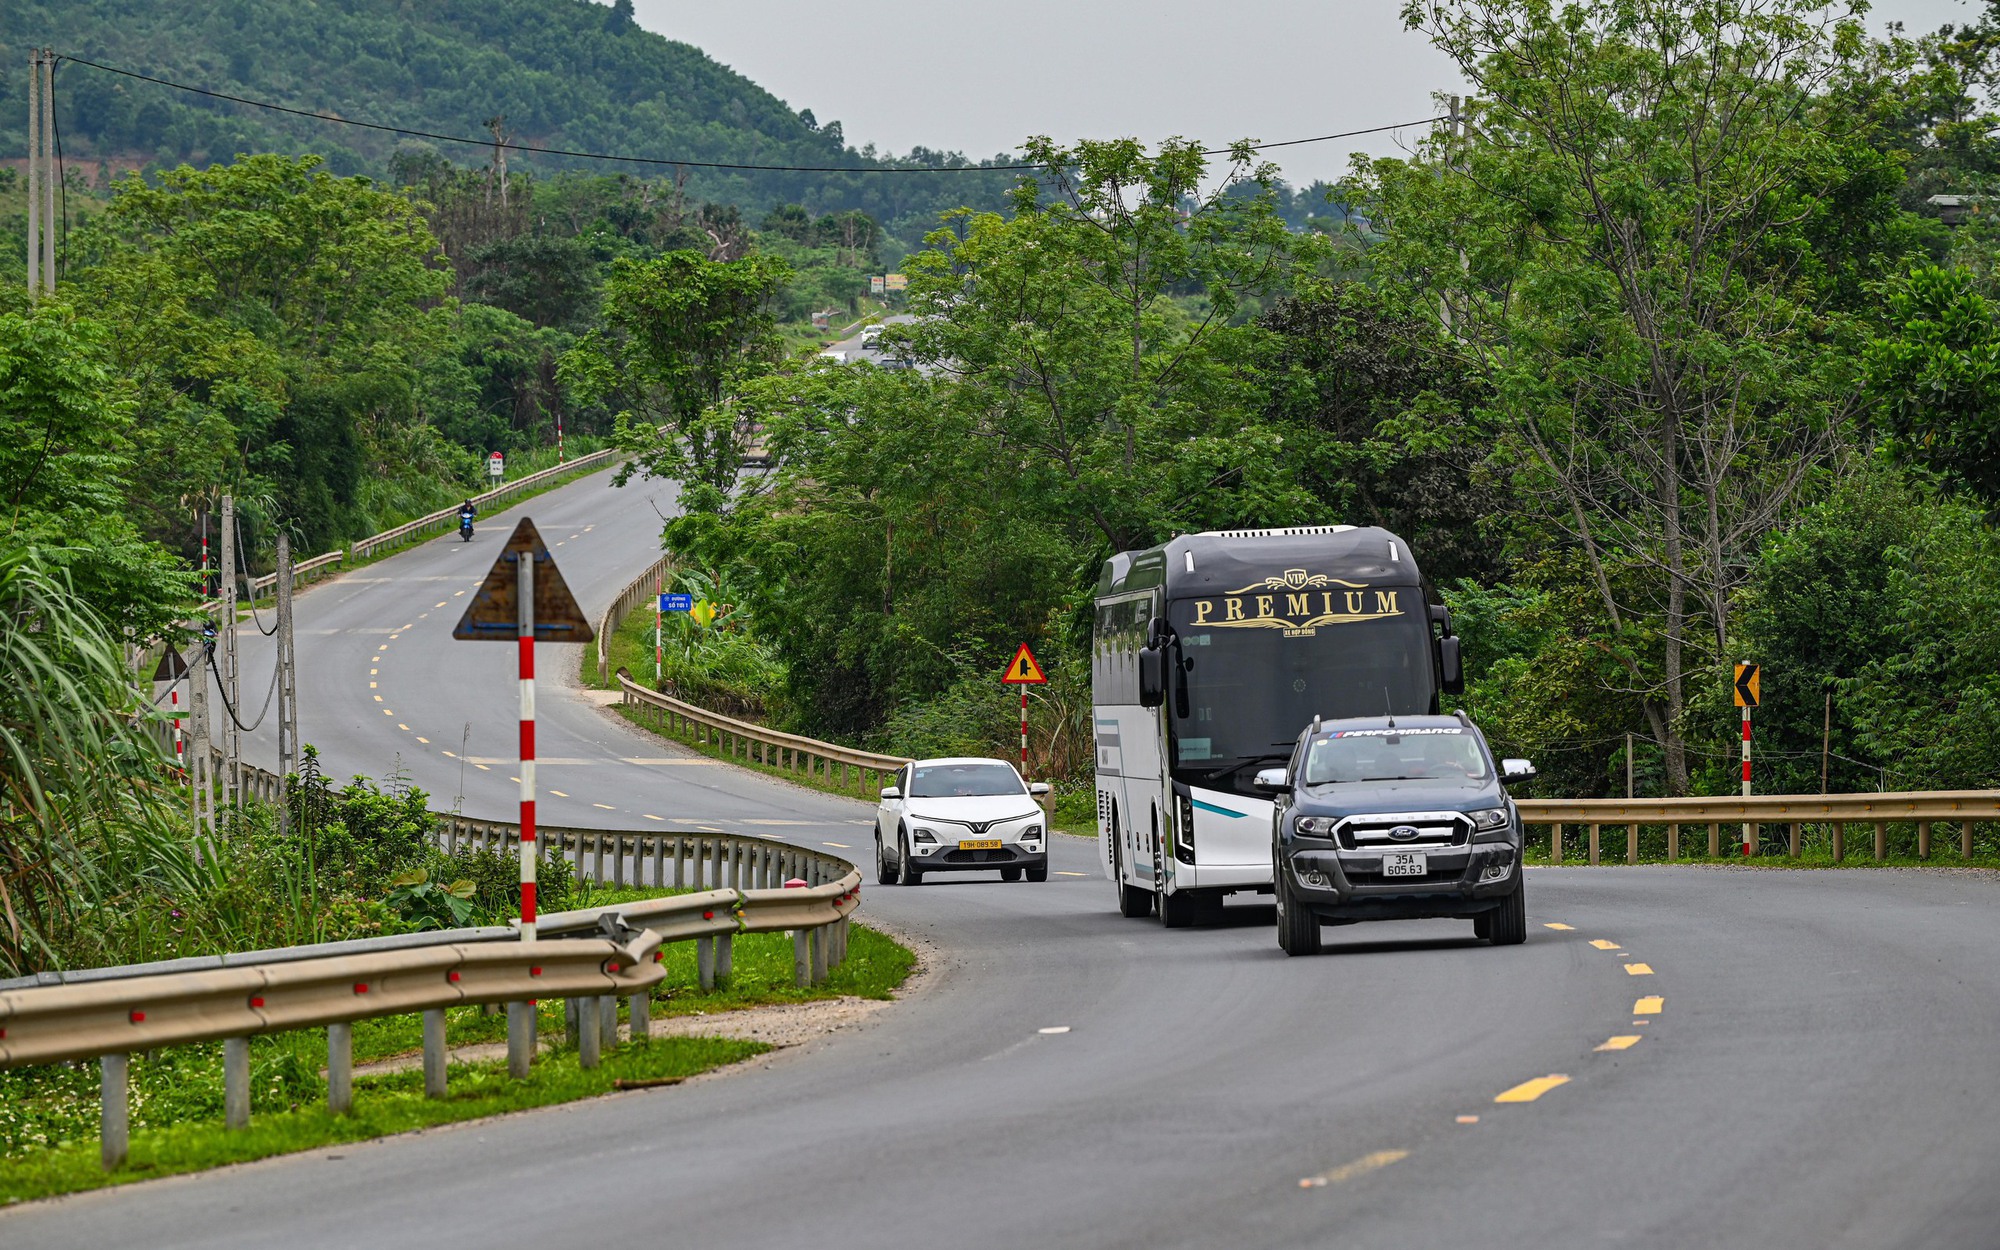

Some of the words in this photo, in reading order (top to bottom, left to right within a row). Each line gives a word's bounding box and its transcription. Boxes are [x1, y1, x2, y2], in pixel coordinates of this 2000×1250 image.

[1288, 573, 1304, 584] VIP
[1195, 591, 1399, 623] PREMIUM
[1342, 728, 1462, 738] PERFORMANCE
[1395, 855, 1414, 864] 35A
[1388, 865, 1422, 875] 605.63
